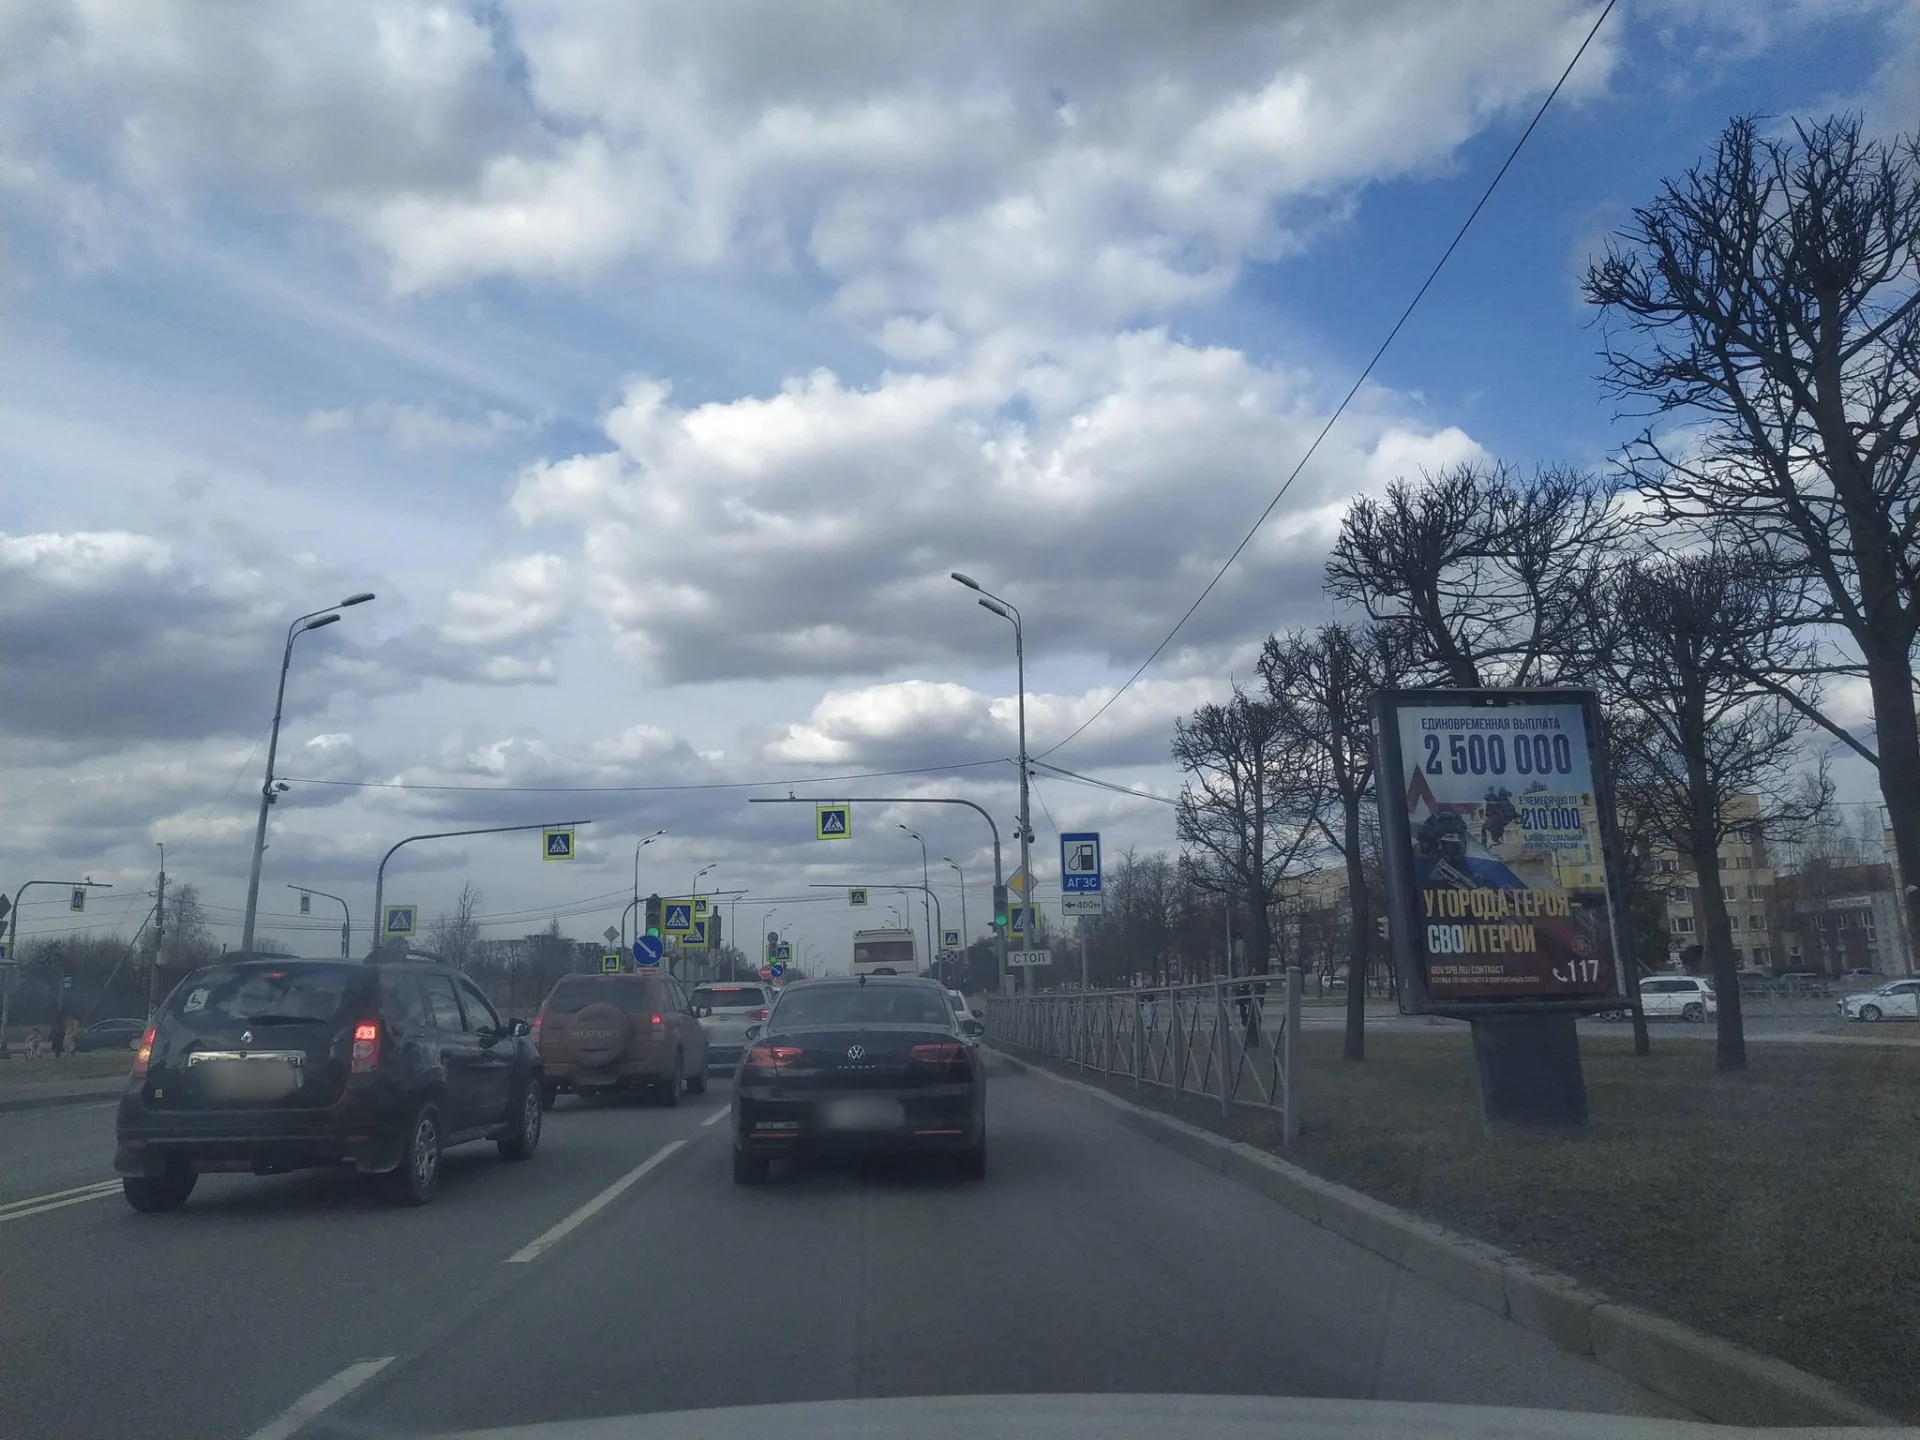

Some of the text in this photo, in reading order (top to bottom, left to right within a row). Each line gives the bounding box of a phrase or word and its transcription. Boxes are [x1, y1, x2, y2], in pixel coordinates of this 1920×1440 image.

[1421, 717, 1561, 730] ЕДИНОВРЕМЕННАЯ ВЫПЛАТА
[1424, 733, 1443, 775] 2
[1448, 733, 1507, 776] 500
[1513, 733, 1572, 775] 000
[1521, 807, 1581, 830] 210 000
[1067, 877, 1098, 889] АГЗС
[1423, 888, 1434, 918] У
[1437, 887, 1570, 921] ГОРОДА-ГЕРОЯ
[1427, 924, 1538, 954] СВОИ ГЕРОИ
[1013, 952, 1046, 963] СТОП
[1567, 959, 1599, 983] 117
